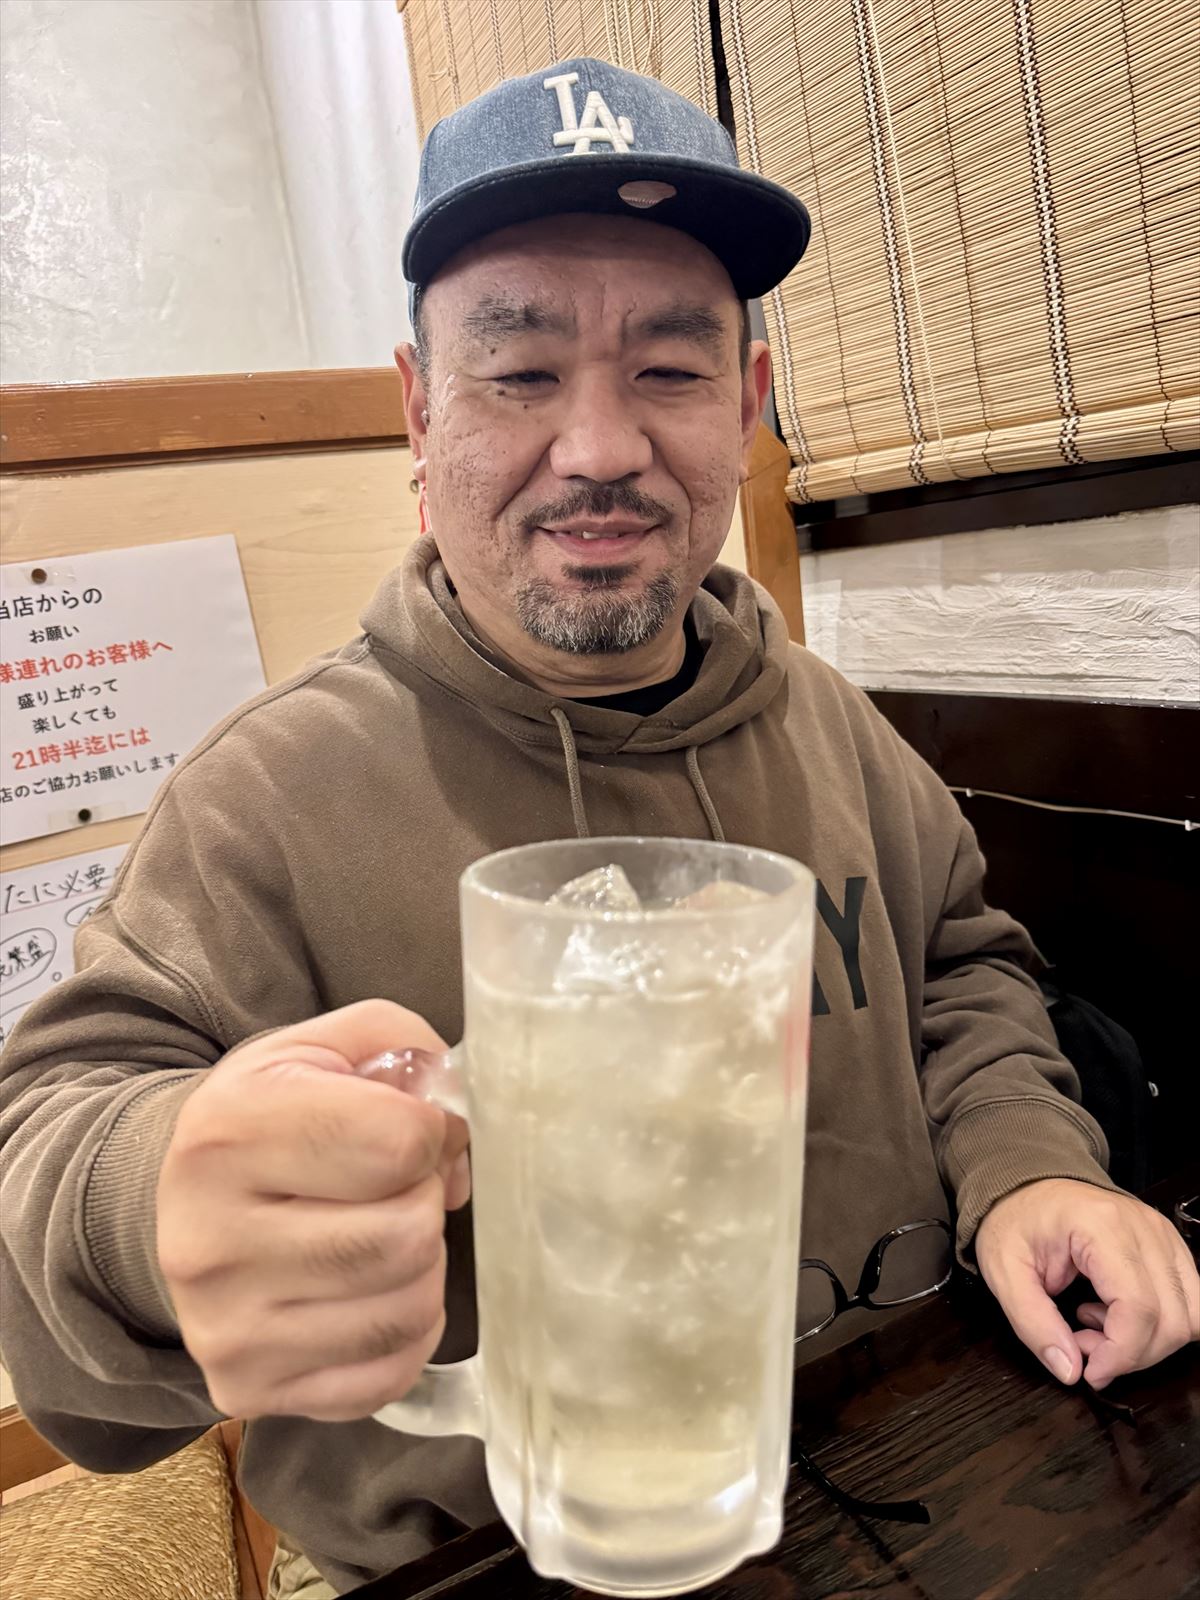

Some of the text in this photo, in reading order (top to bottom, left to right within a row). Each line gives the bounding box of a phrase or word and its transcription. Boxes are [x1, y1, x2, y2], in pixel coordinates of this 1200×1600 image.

[544, 72, 630, 155] LA
[29, 624, 80, 644] お願い
[17, 678, 119, 710] 盛り上がって
[32, 705, 117, 734] 楽しくても
[11, 727, 152, 772] 21時半迄には
[813, 877, 867, 1015] Y
